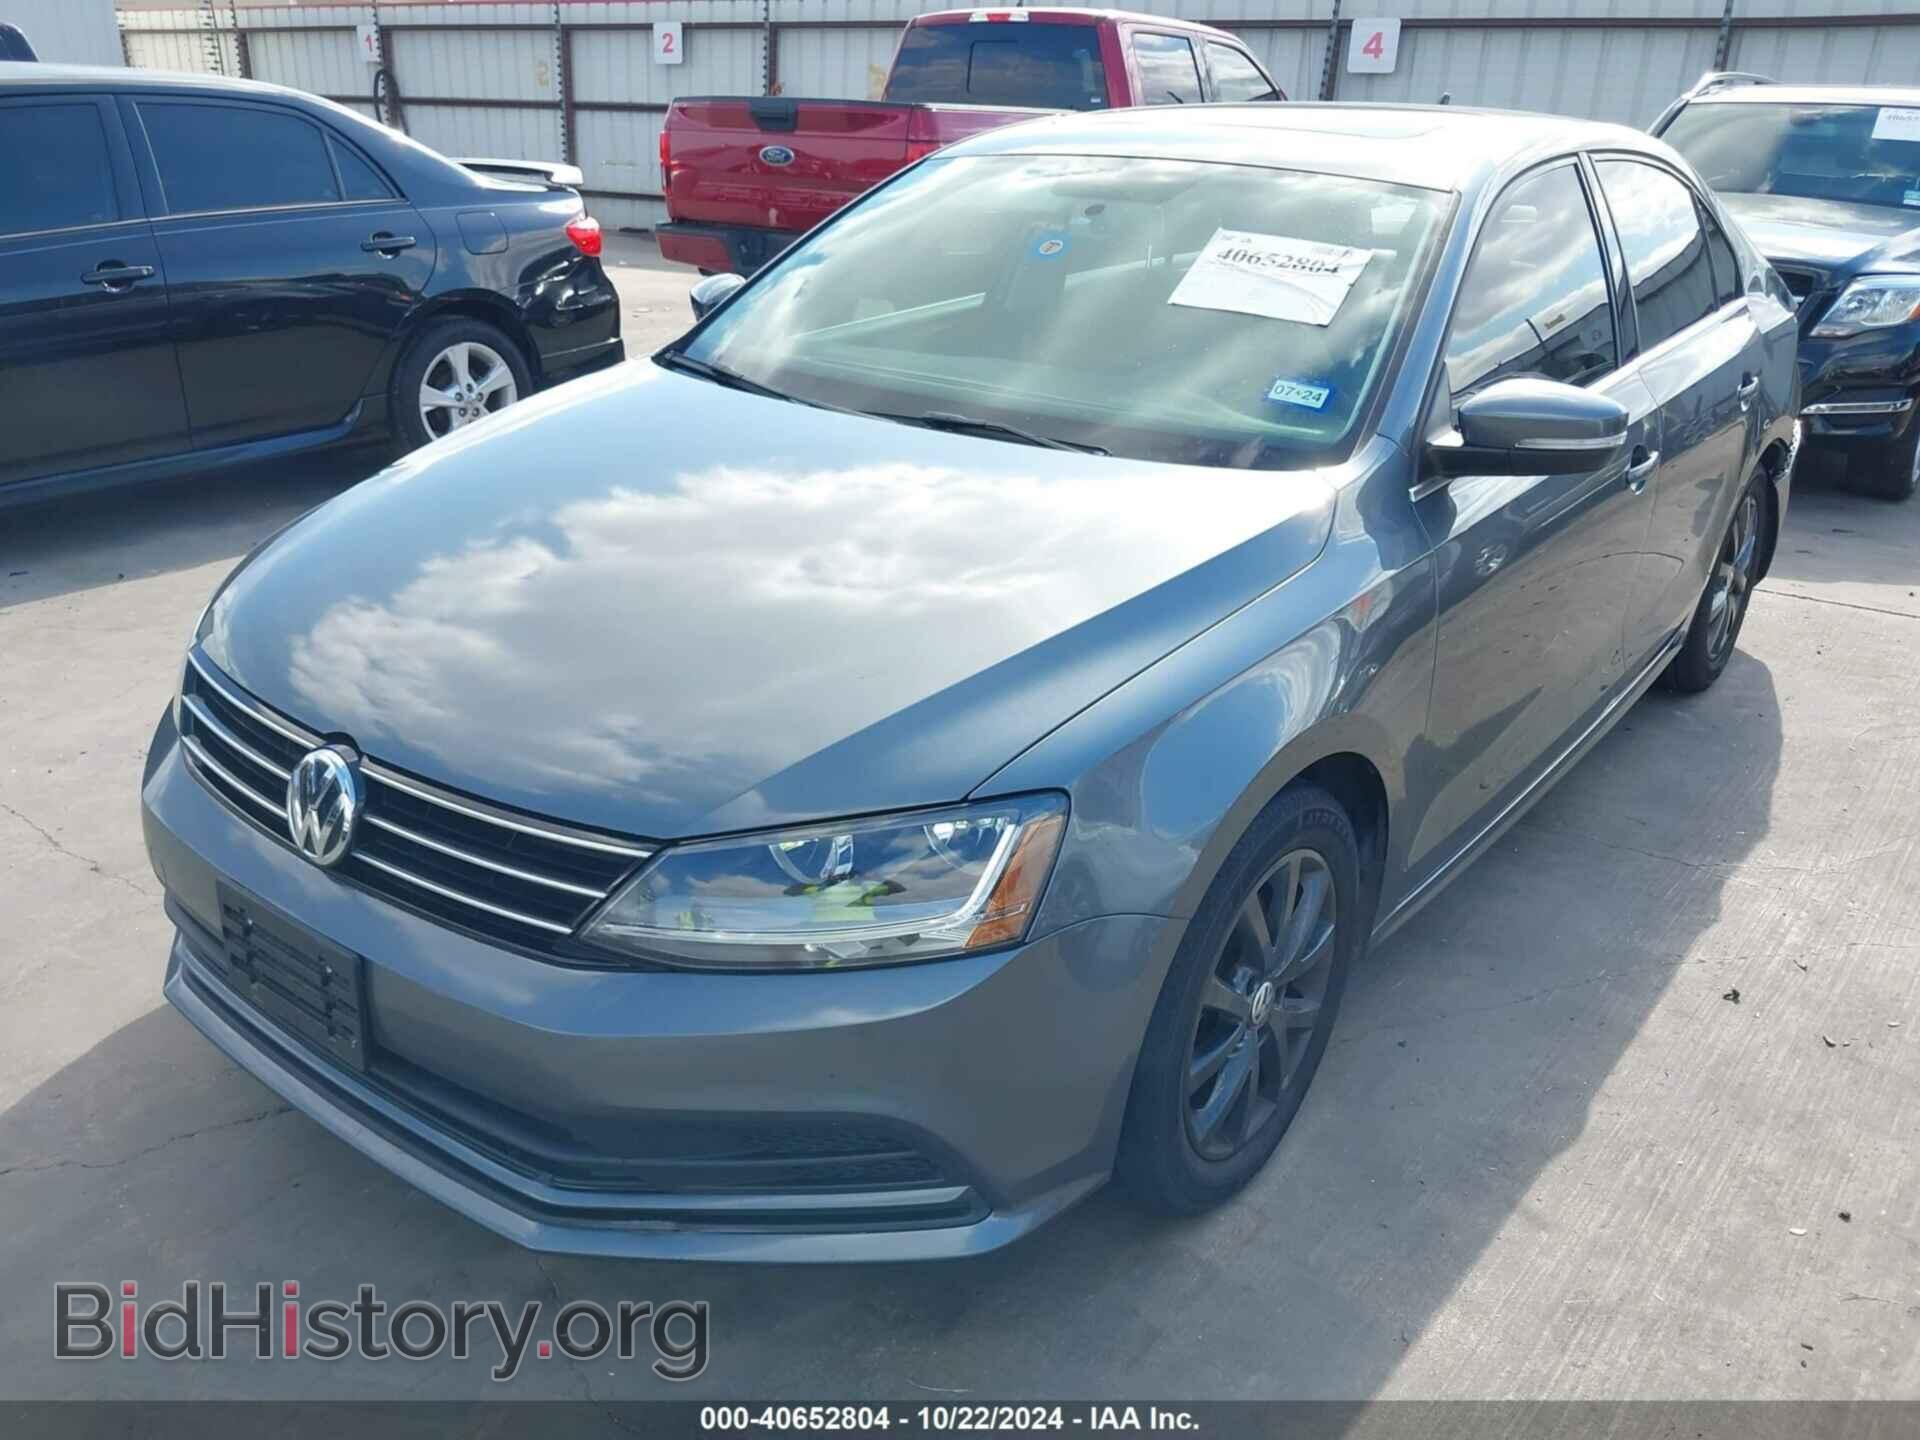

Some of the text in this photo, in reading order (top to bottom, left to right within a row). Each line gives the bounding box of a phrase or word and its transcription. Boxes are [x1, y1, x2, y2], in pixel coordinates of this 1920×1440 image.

[365, 34, 374, 52] 1
[661, 32, 674, 53] 2
[1362, 31, 1384, 59] 4
[1216, 247, 1341, 275] 40652804
